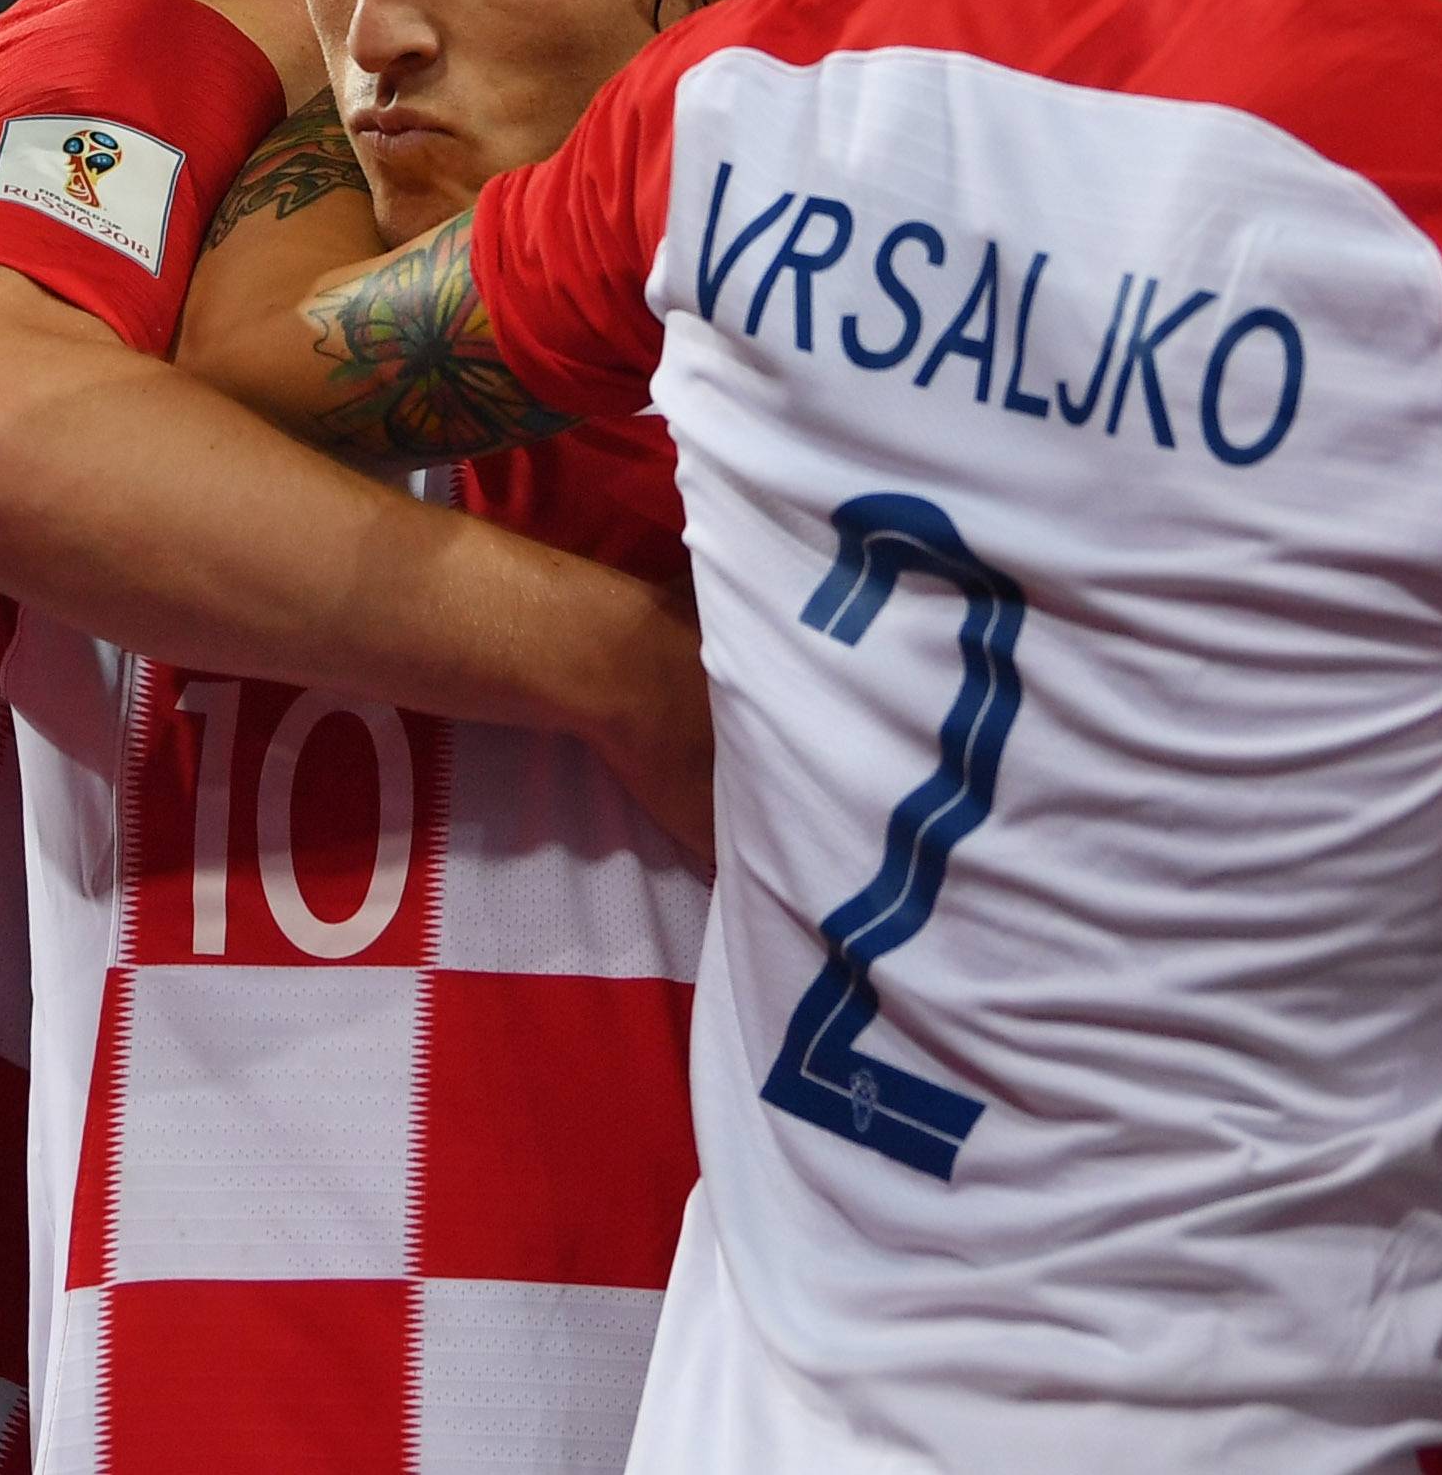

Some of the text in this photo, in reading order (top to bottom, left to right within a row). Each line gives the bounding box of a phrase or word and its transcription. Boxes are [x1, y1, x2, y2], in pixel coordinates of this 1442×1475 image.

[3, 184, 151, 259] RUSSIA 2018
[38, 188, 122, 230] FIFA WORLD CUP
[695, 161, 1304, 468] VRSALJKO
[173, 679, 415, 960] 10
[758, 491, 1027, 1185] 2
